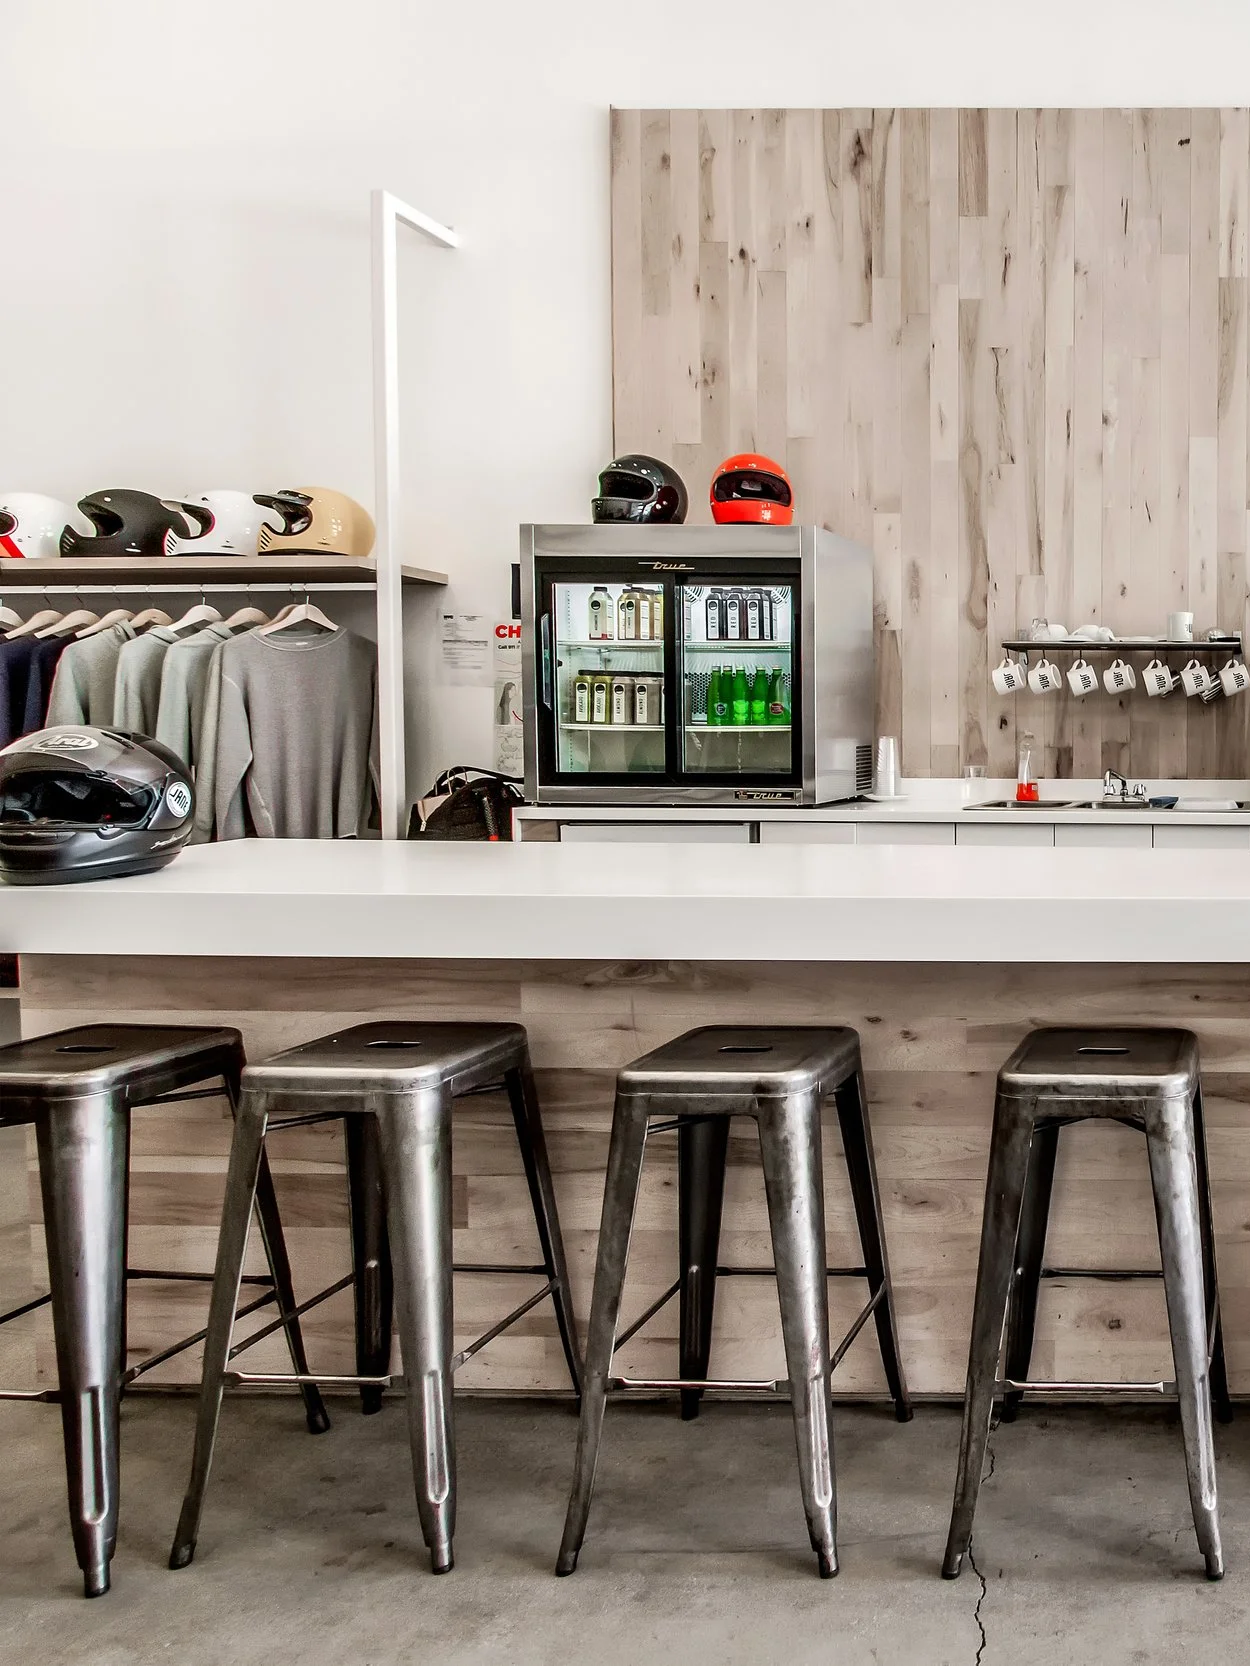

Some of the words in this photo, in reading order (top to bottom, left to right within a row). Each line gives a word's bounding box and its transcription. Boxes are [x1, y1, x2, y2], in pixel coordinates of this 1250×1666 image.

[1004, 673, 1015, 688] JANE
[1039, 674, 1050, 689] JANE
[1080, 673, 1091, 689] JANE
[1113, 671, 1124, 687] JANE
[1155, 673, 1166, 690] JANE
[1192, 672, 1203, 689] JANE
[1233, 672, 1244, 688] JANE
[169, 788, 189, 812] JANE
